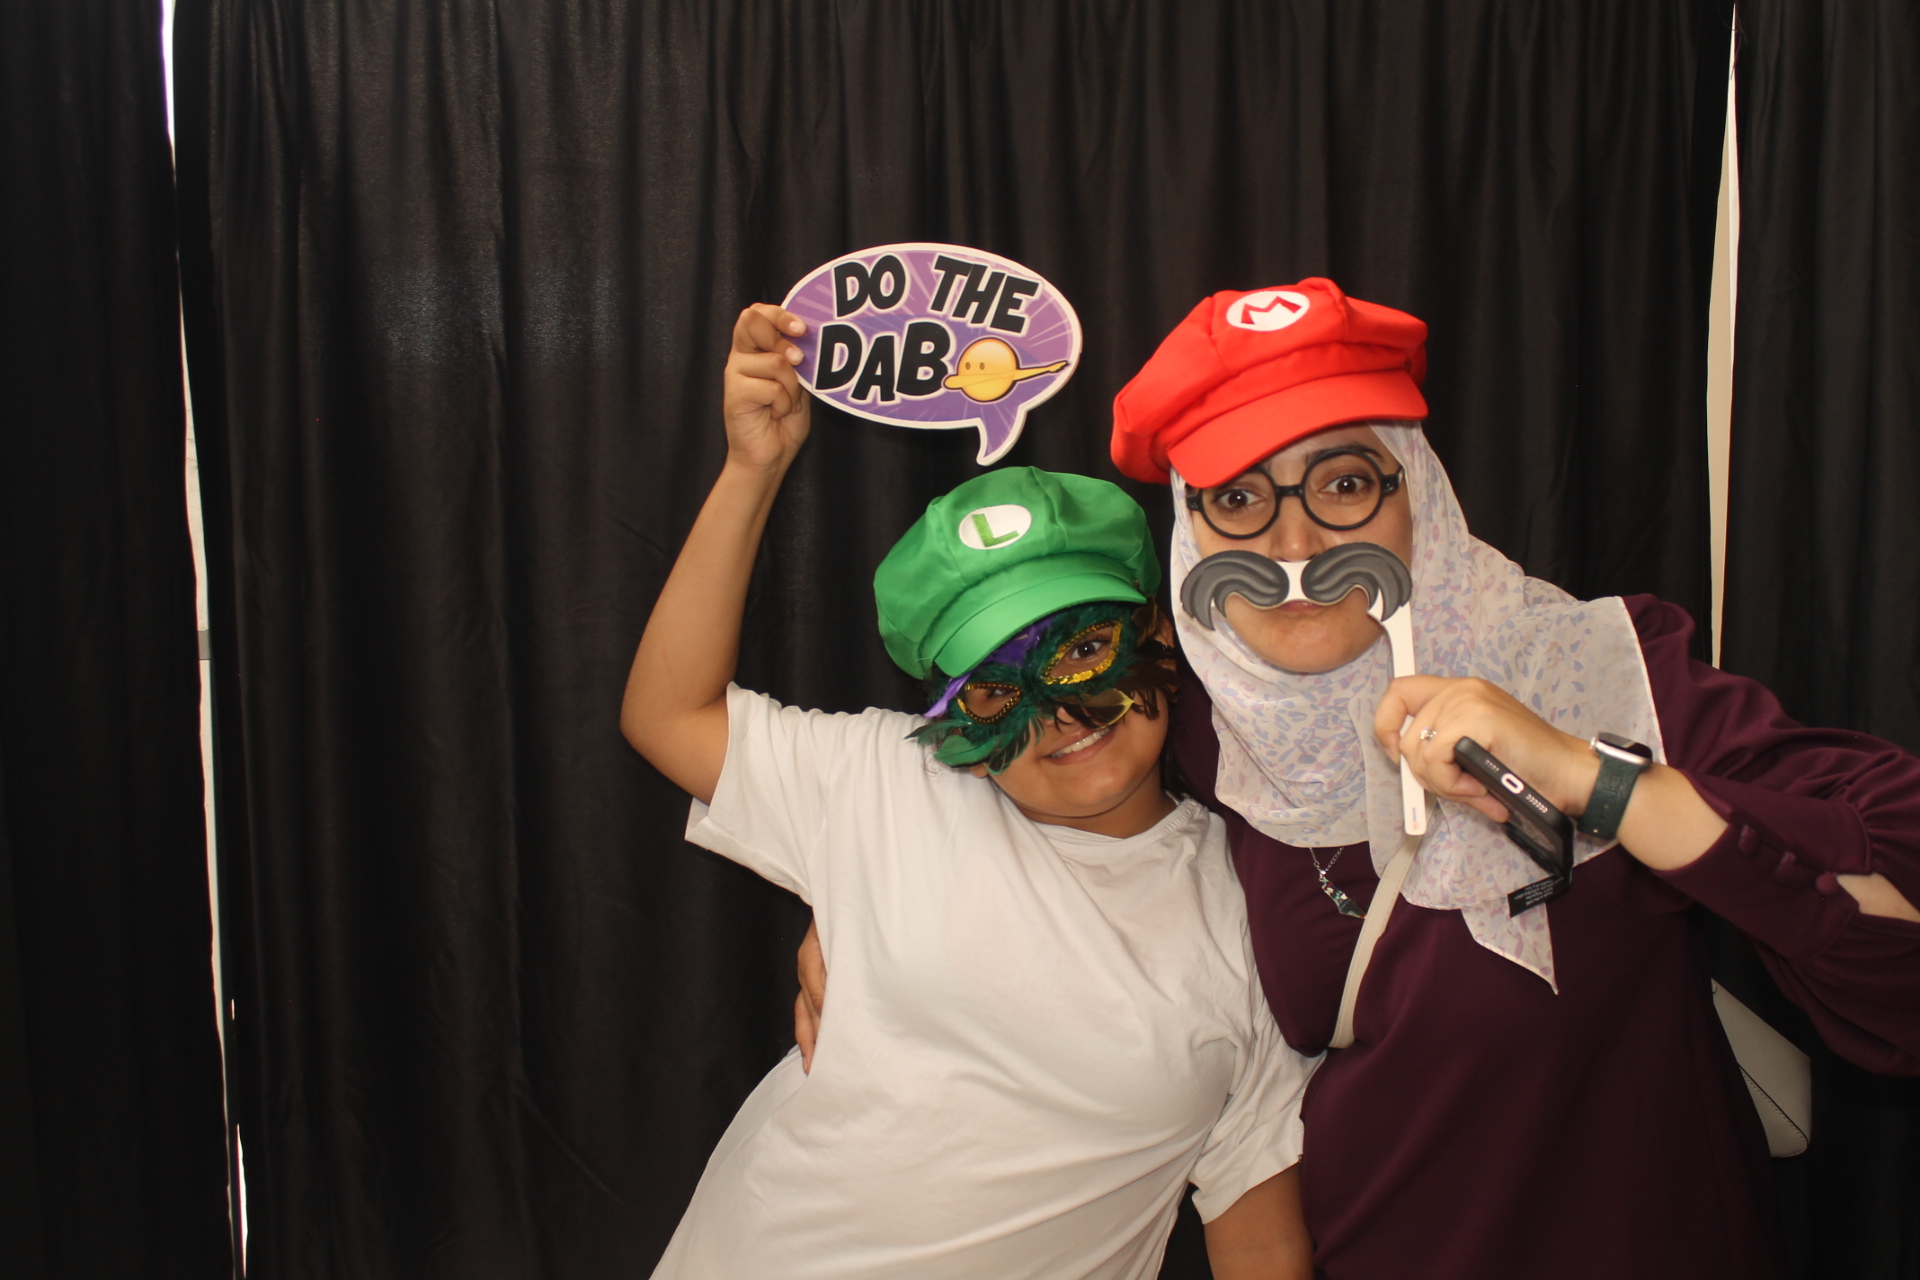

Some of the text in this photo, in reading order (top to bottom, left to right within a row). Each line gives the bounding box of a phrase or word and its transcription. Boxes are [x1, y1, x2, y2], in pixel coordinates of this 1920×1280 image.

[834, 255, 1040, 334] DO THE
[1241, 296, 1302, 325] M
[814, 321, 951, 402] DAB
[971, 513, 1020, 548] L
